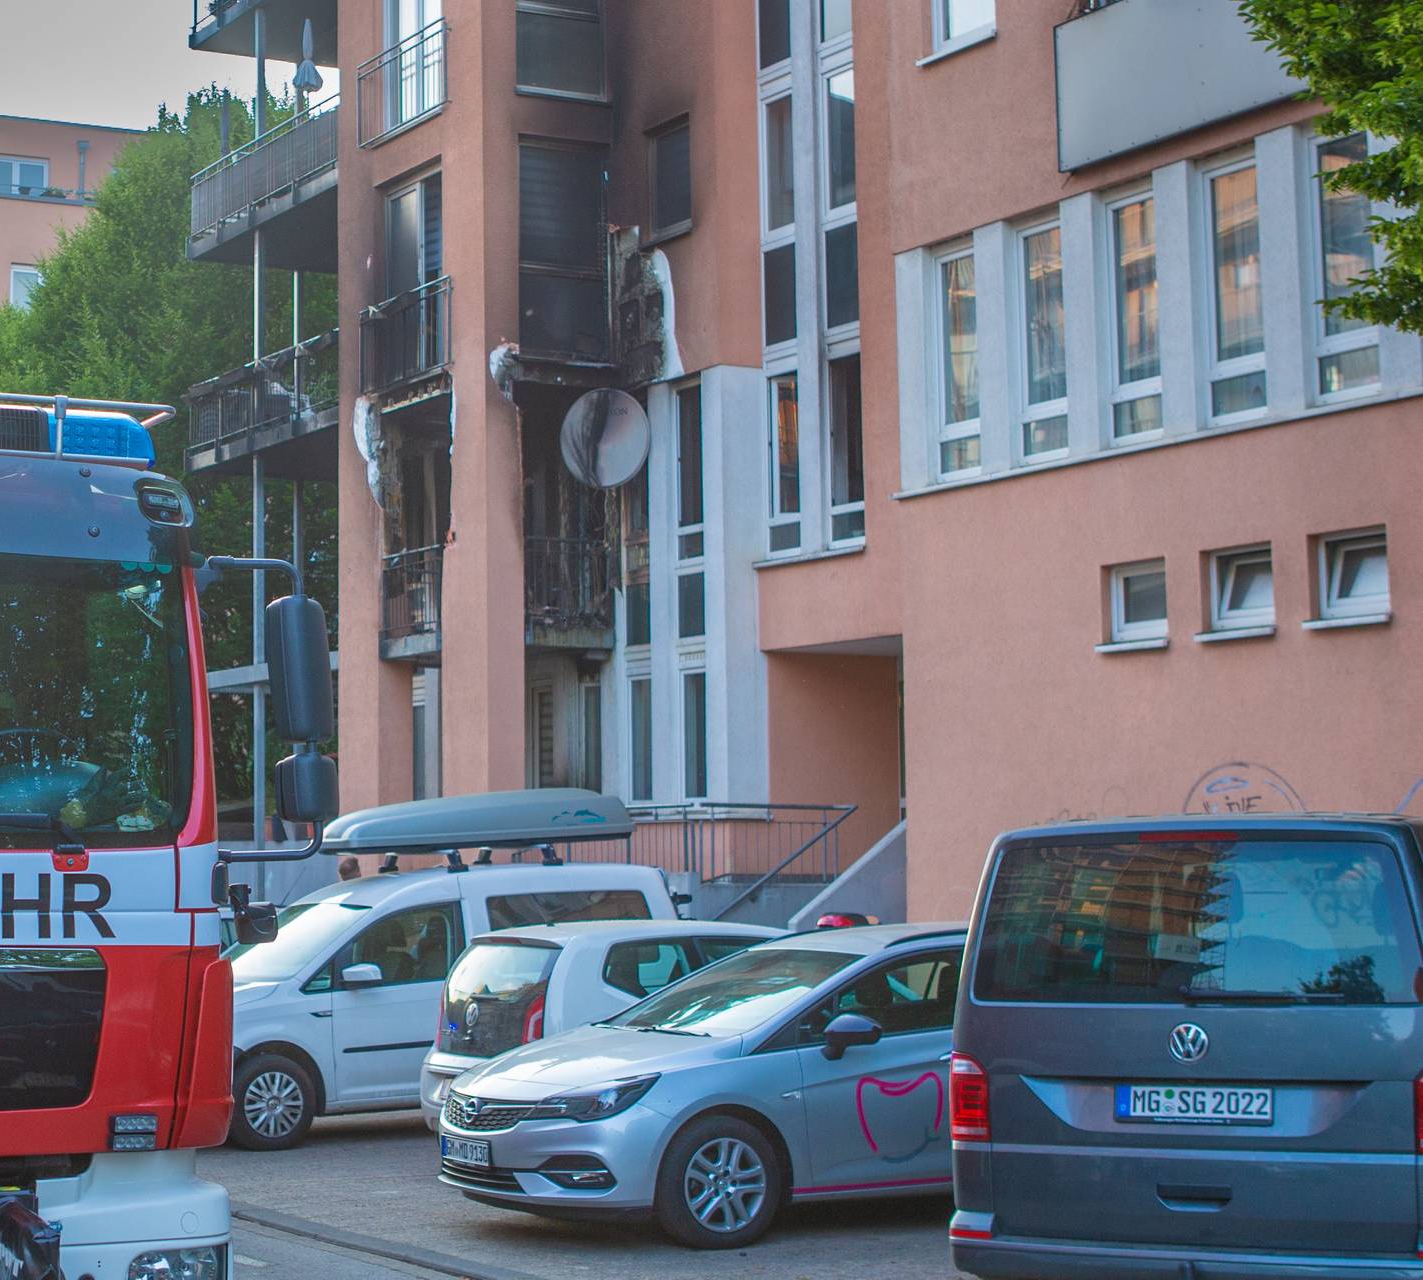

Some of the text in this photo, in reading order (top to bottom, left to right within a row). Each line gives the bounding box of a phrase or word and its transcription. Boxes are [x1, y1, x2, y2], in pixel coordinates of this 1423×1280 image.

[1132, 1089, 1160, 1113] MG
[1178, 1089, 1206, 1114] SG
[1212, 1091, 1268, 1116] 2022
